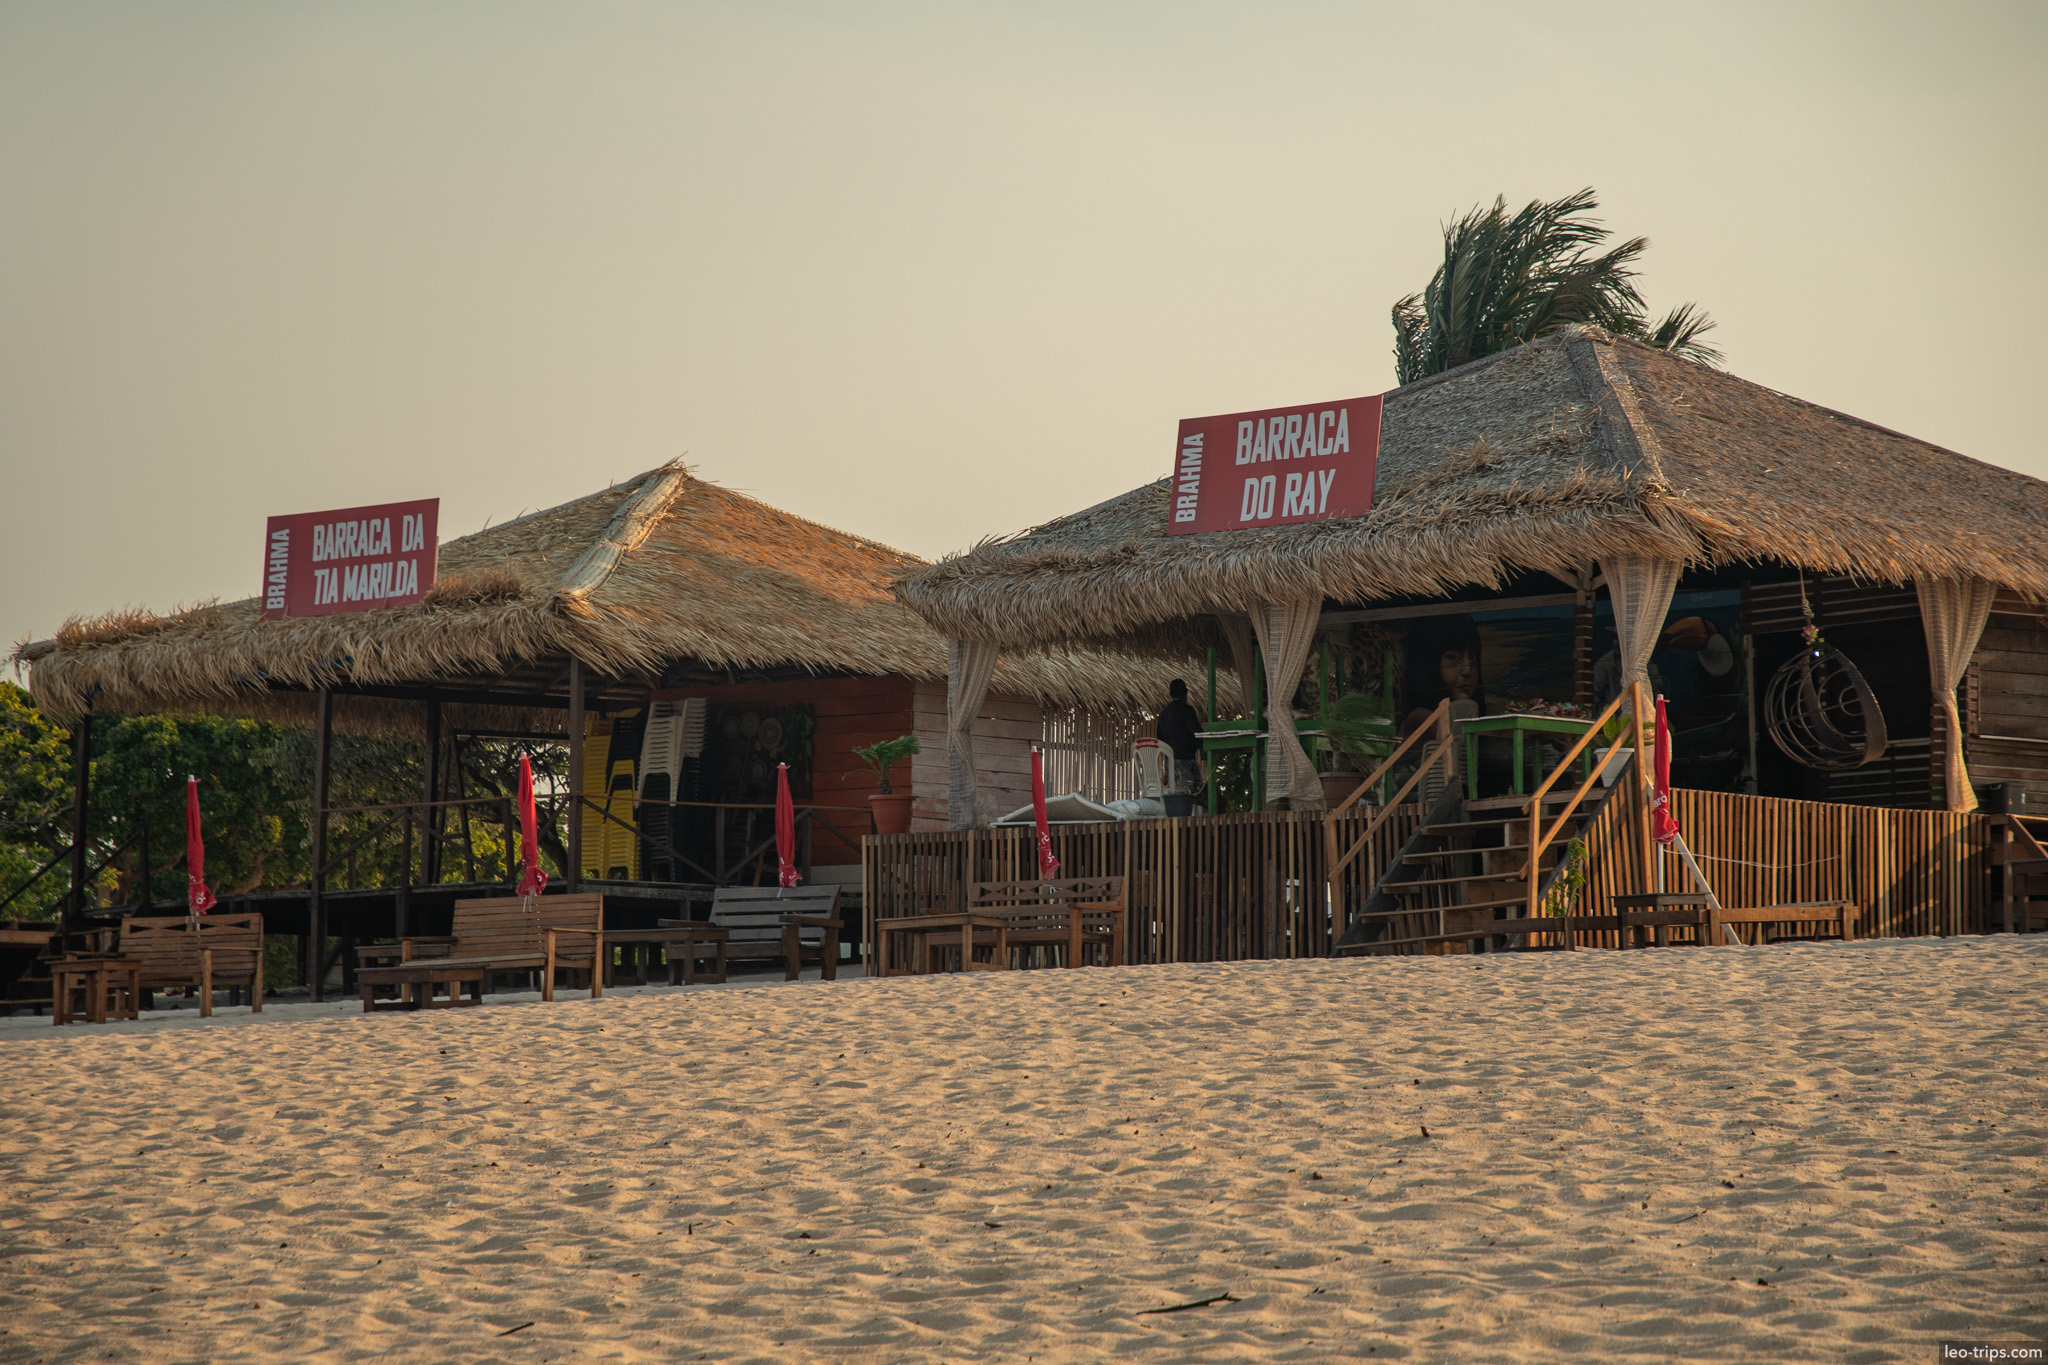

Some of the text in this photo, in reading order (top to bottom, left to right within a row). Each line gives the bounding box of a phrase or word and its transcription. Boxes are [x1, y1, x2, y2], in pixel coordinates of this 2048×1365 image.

[1235, 408, 1349, 465] BARRACA
[1175, 433, 1204, 522] BRAHMA
[1240, 469, 1336, 522] DO RAY
[312, 513, 424, 562] BARRACA DA
[266, 529, 290, 609] BRAHMA
[314, 559, 418, 605] TIA MARILDA
